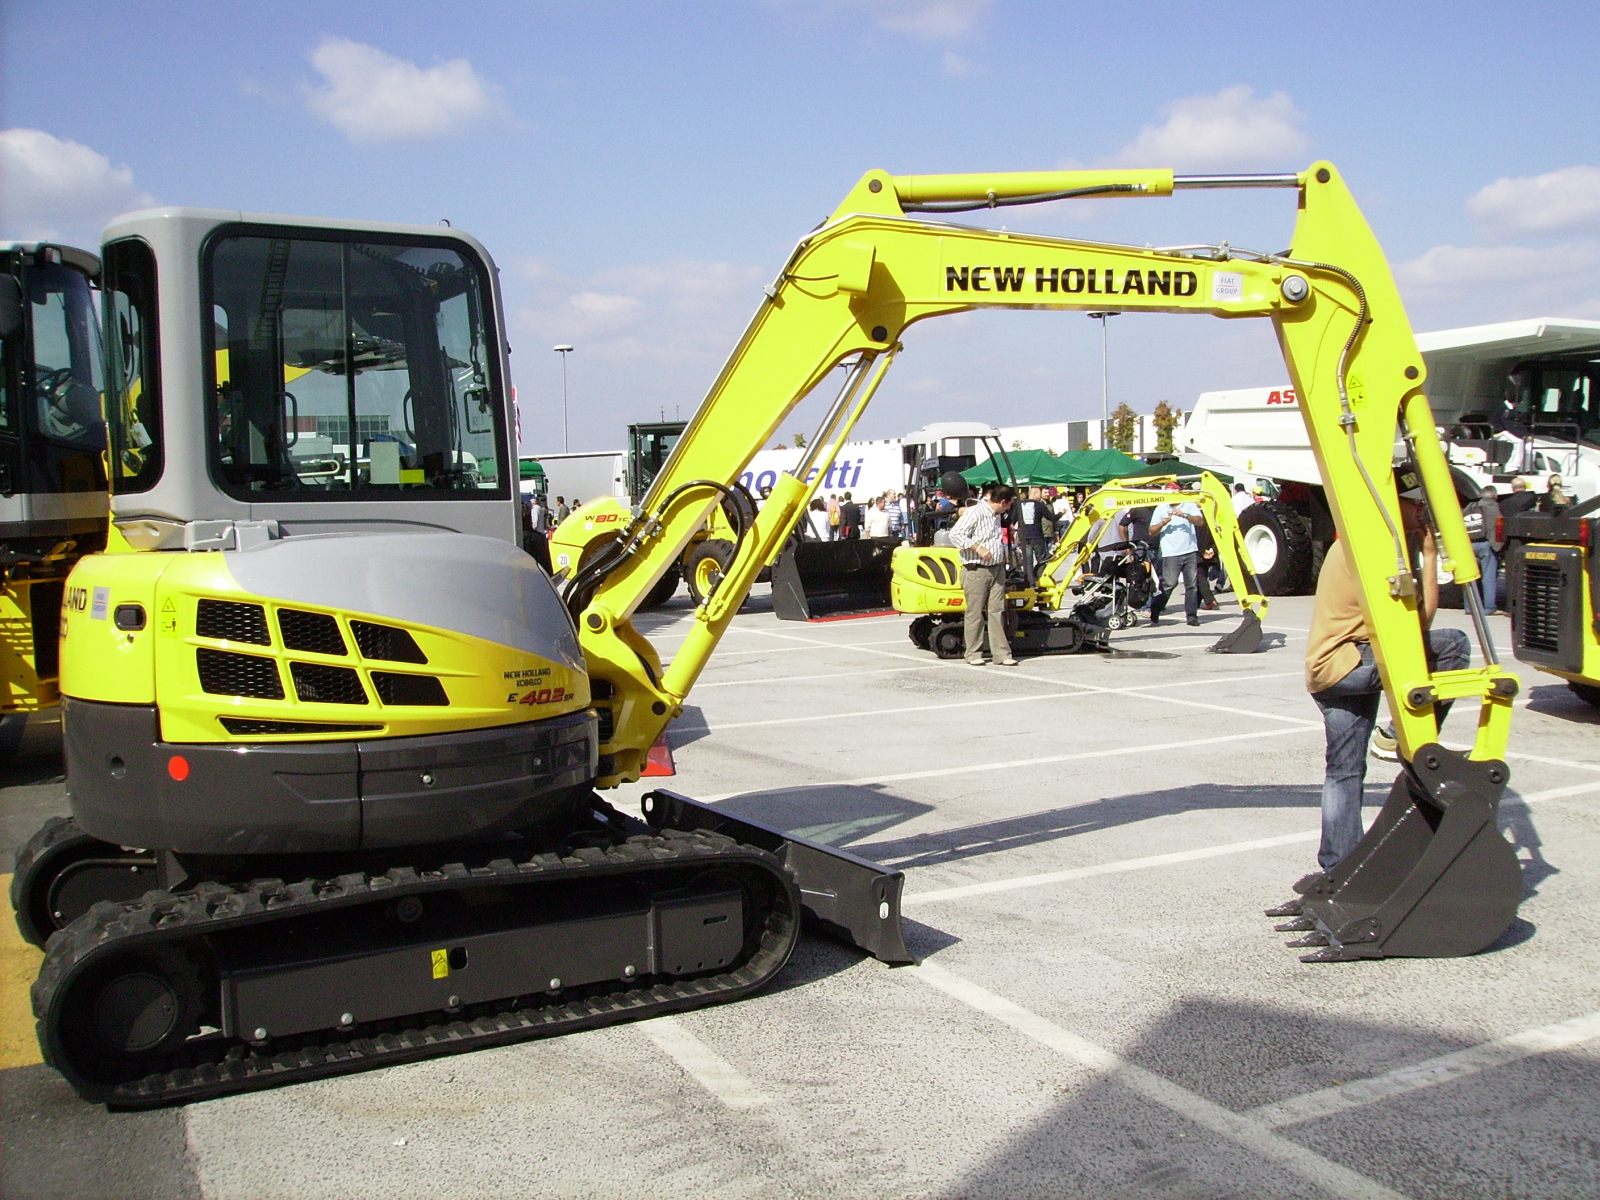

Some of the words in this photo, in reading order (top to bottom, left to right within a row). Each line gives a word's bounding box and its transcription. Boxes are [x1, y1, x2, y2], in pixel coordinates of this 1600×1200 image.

[945, 266, 1025, 292] NEW
[1036, 267, 1198, 297] HOLLAND
[1220, 277, 1235, 285] FIAT
[1215, 287, 1238, 295] GROUP
[1133, 496, 1165, 504] HOLLAND
[503, 671, 521, 679] NEW
[522, 667, 551, 678] HOLLAND
